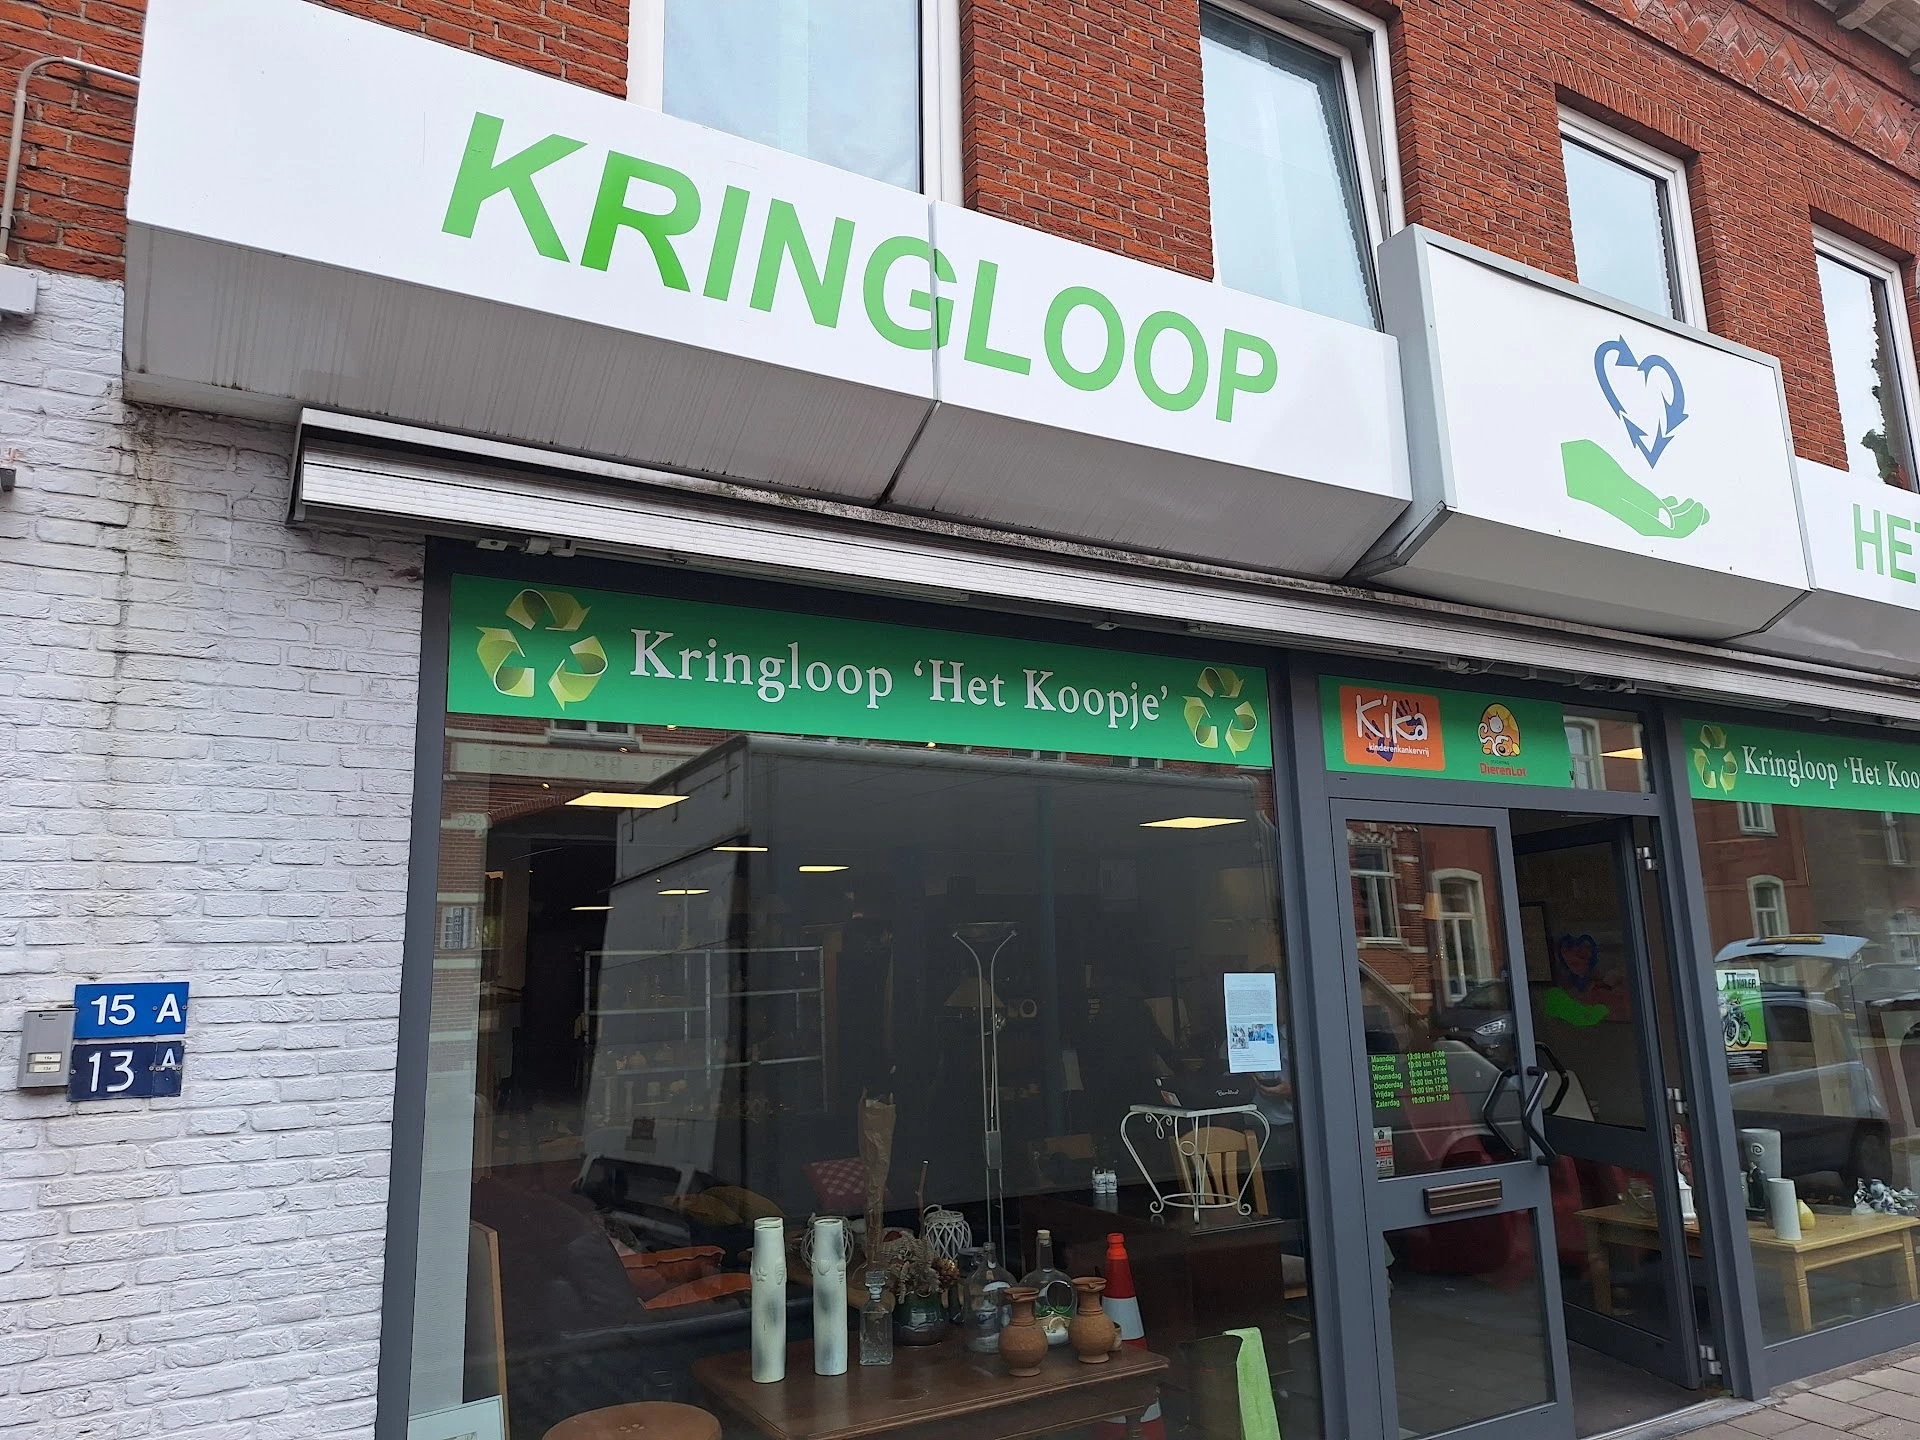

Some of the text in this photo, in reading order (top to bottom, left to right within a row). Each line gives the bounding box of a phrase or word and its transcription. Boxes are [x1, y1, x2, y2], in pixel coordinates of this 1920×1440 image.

[441, 112, 1279, 423] KRINGLOOP
[1853, 503, 1920, 584] HE
[630, 628, 893, 710] Kringloop
[1479, 763, 1527, 777] DierenLot
[1741, 745, 1839, 790] Kringloop
[1885, 760, 1920, 790] Koo
[91, 993, 181, 1026] 15 A
[88, 1048, 177, 1093] 13 A
[1372, 1064, 1395, 1072] Dinsdag
[1372, 1072, 1402, 1081] Woensdag
[1373, 1081, 1404, 1090] Donderdag
[1374, 1091, 1395, 1099] Vrijdag
[1375, 1100, 1401, 1108] Zaterdag
